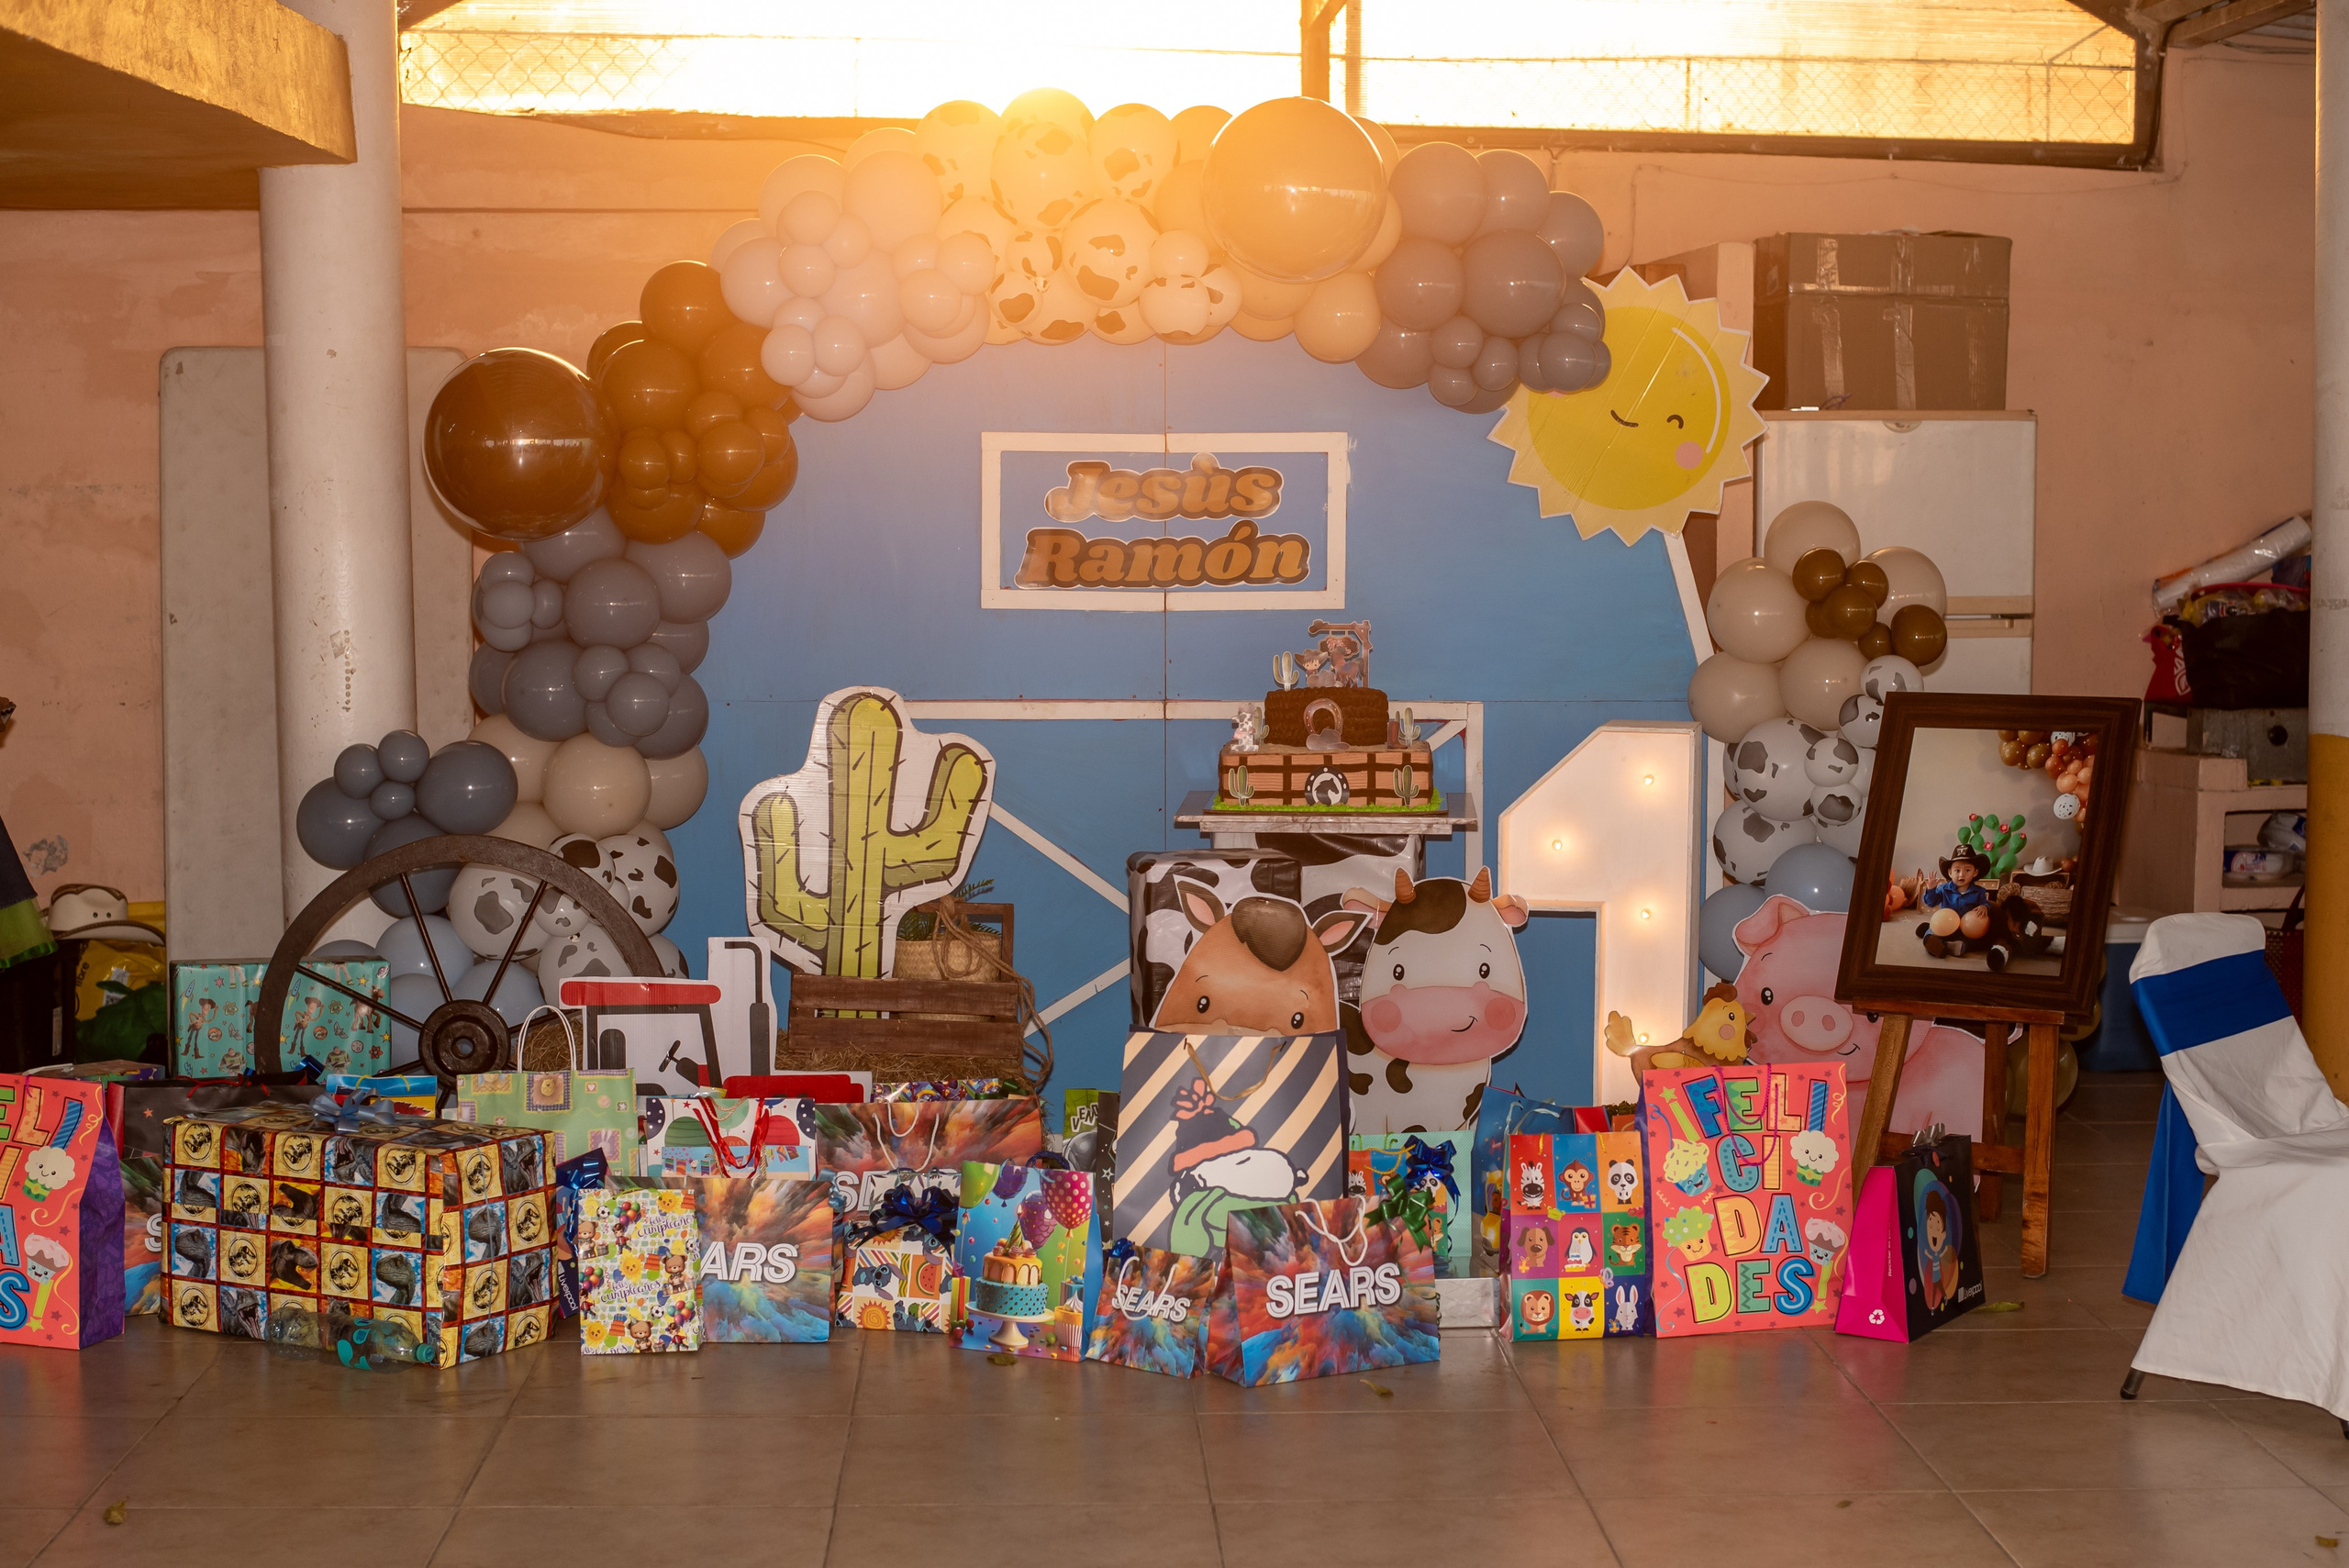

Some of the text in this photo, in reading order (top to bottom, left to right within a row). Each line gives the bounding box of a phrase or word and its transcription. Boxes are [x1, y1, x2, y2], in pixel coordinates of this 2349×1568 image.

[1019, 524, 1307, 584] Ramón
[1716, 1134, 1782, 1193] CI
[1713, 1193, 1805, 1258] DA
[558, 1273, 579, 1311] Liverpool
[1111, 1284, 1191, 1322] SEARS
[1265, 1262, 1401, 1318] SEARS
[1964, 1280, 1983, 1300] Liverpool
